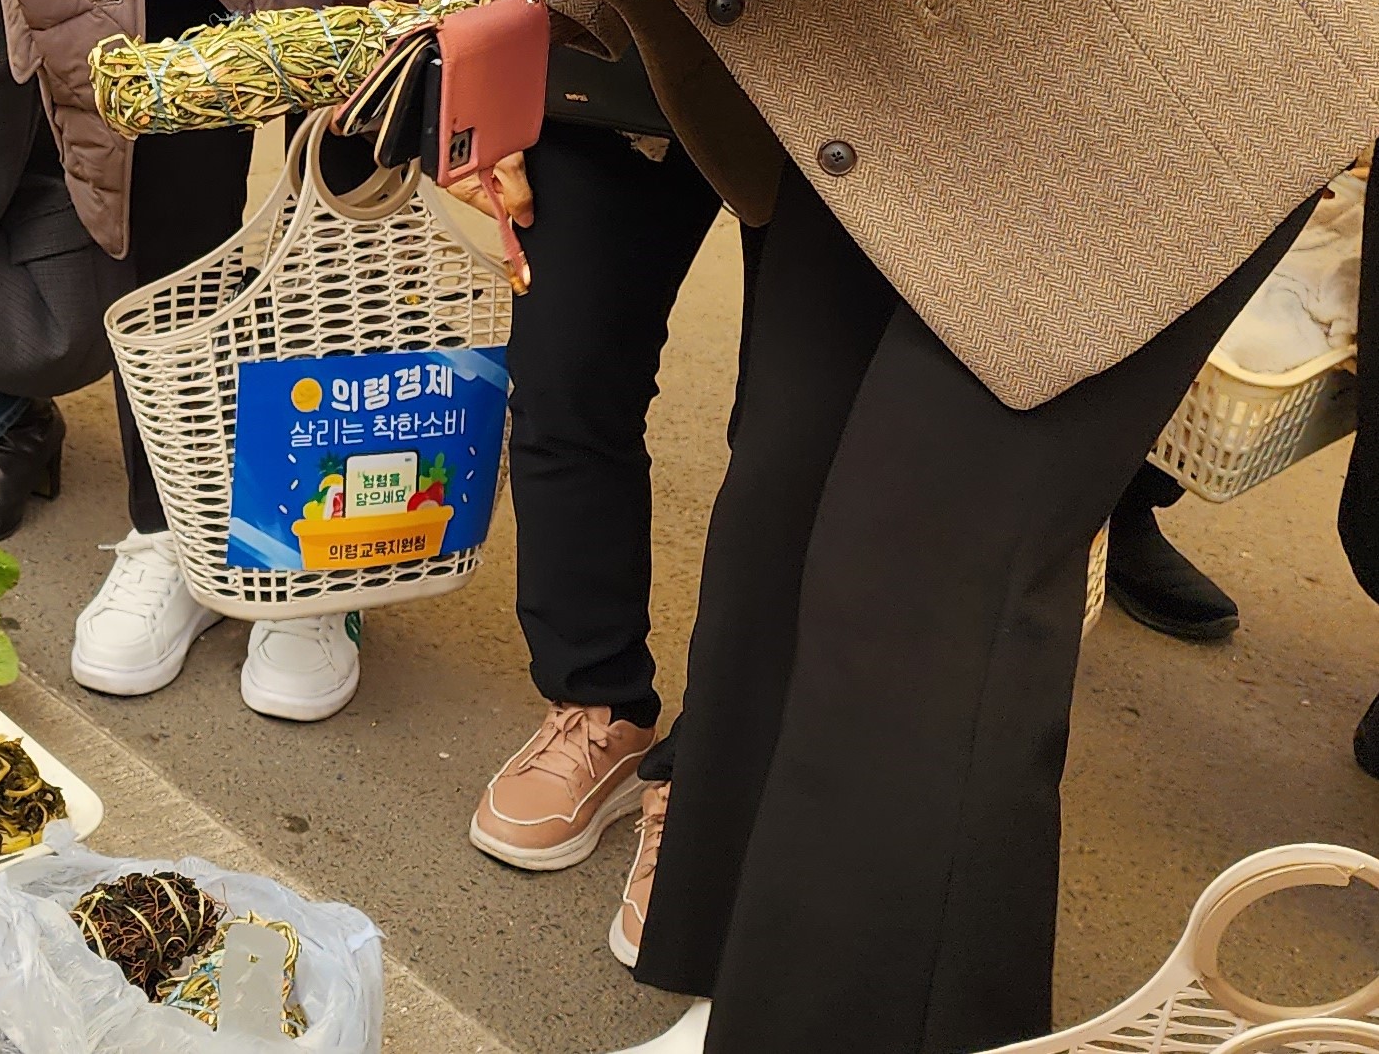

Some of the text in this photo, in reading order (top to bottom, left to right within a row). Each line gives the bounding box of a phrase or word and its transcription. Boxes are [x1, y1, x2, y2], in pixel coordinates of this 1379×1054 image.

[330, 363, 454, 413] 의령경제
[289, 407, 466, 448] 살리는 착한소비
[328, 534, 427, 561] 의령교육지원청
